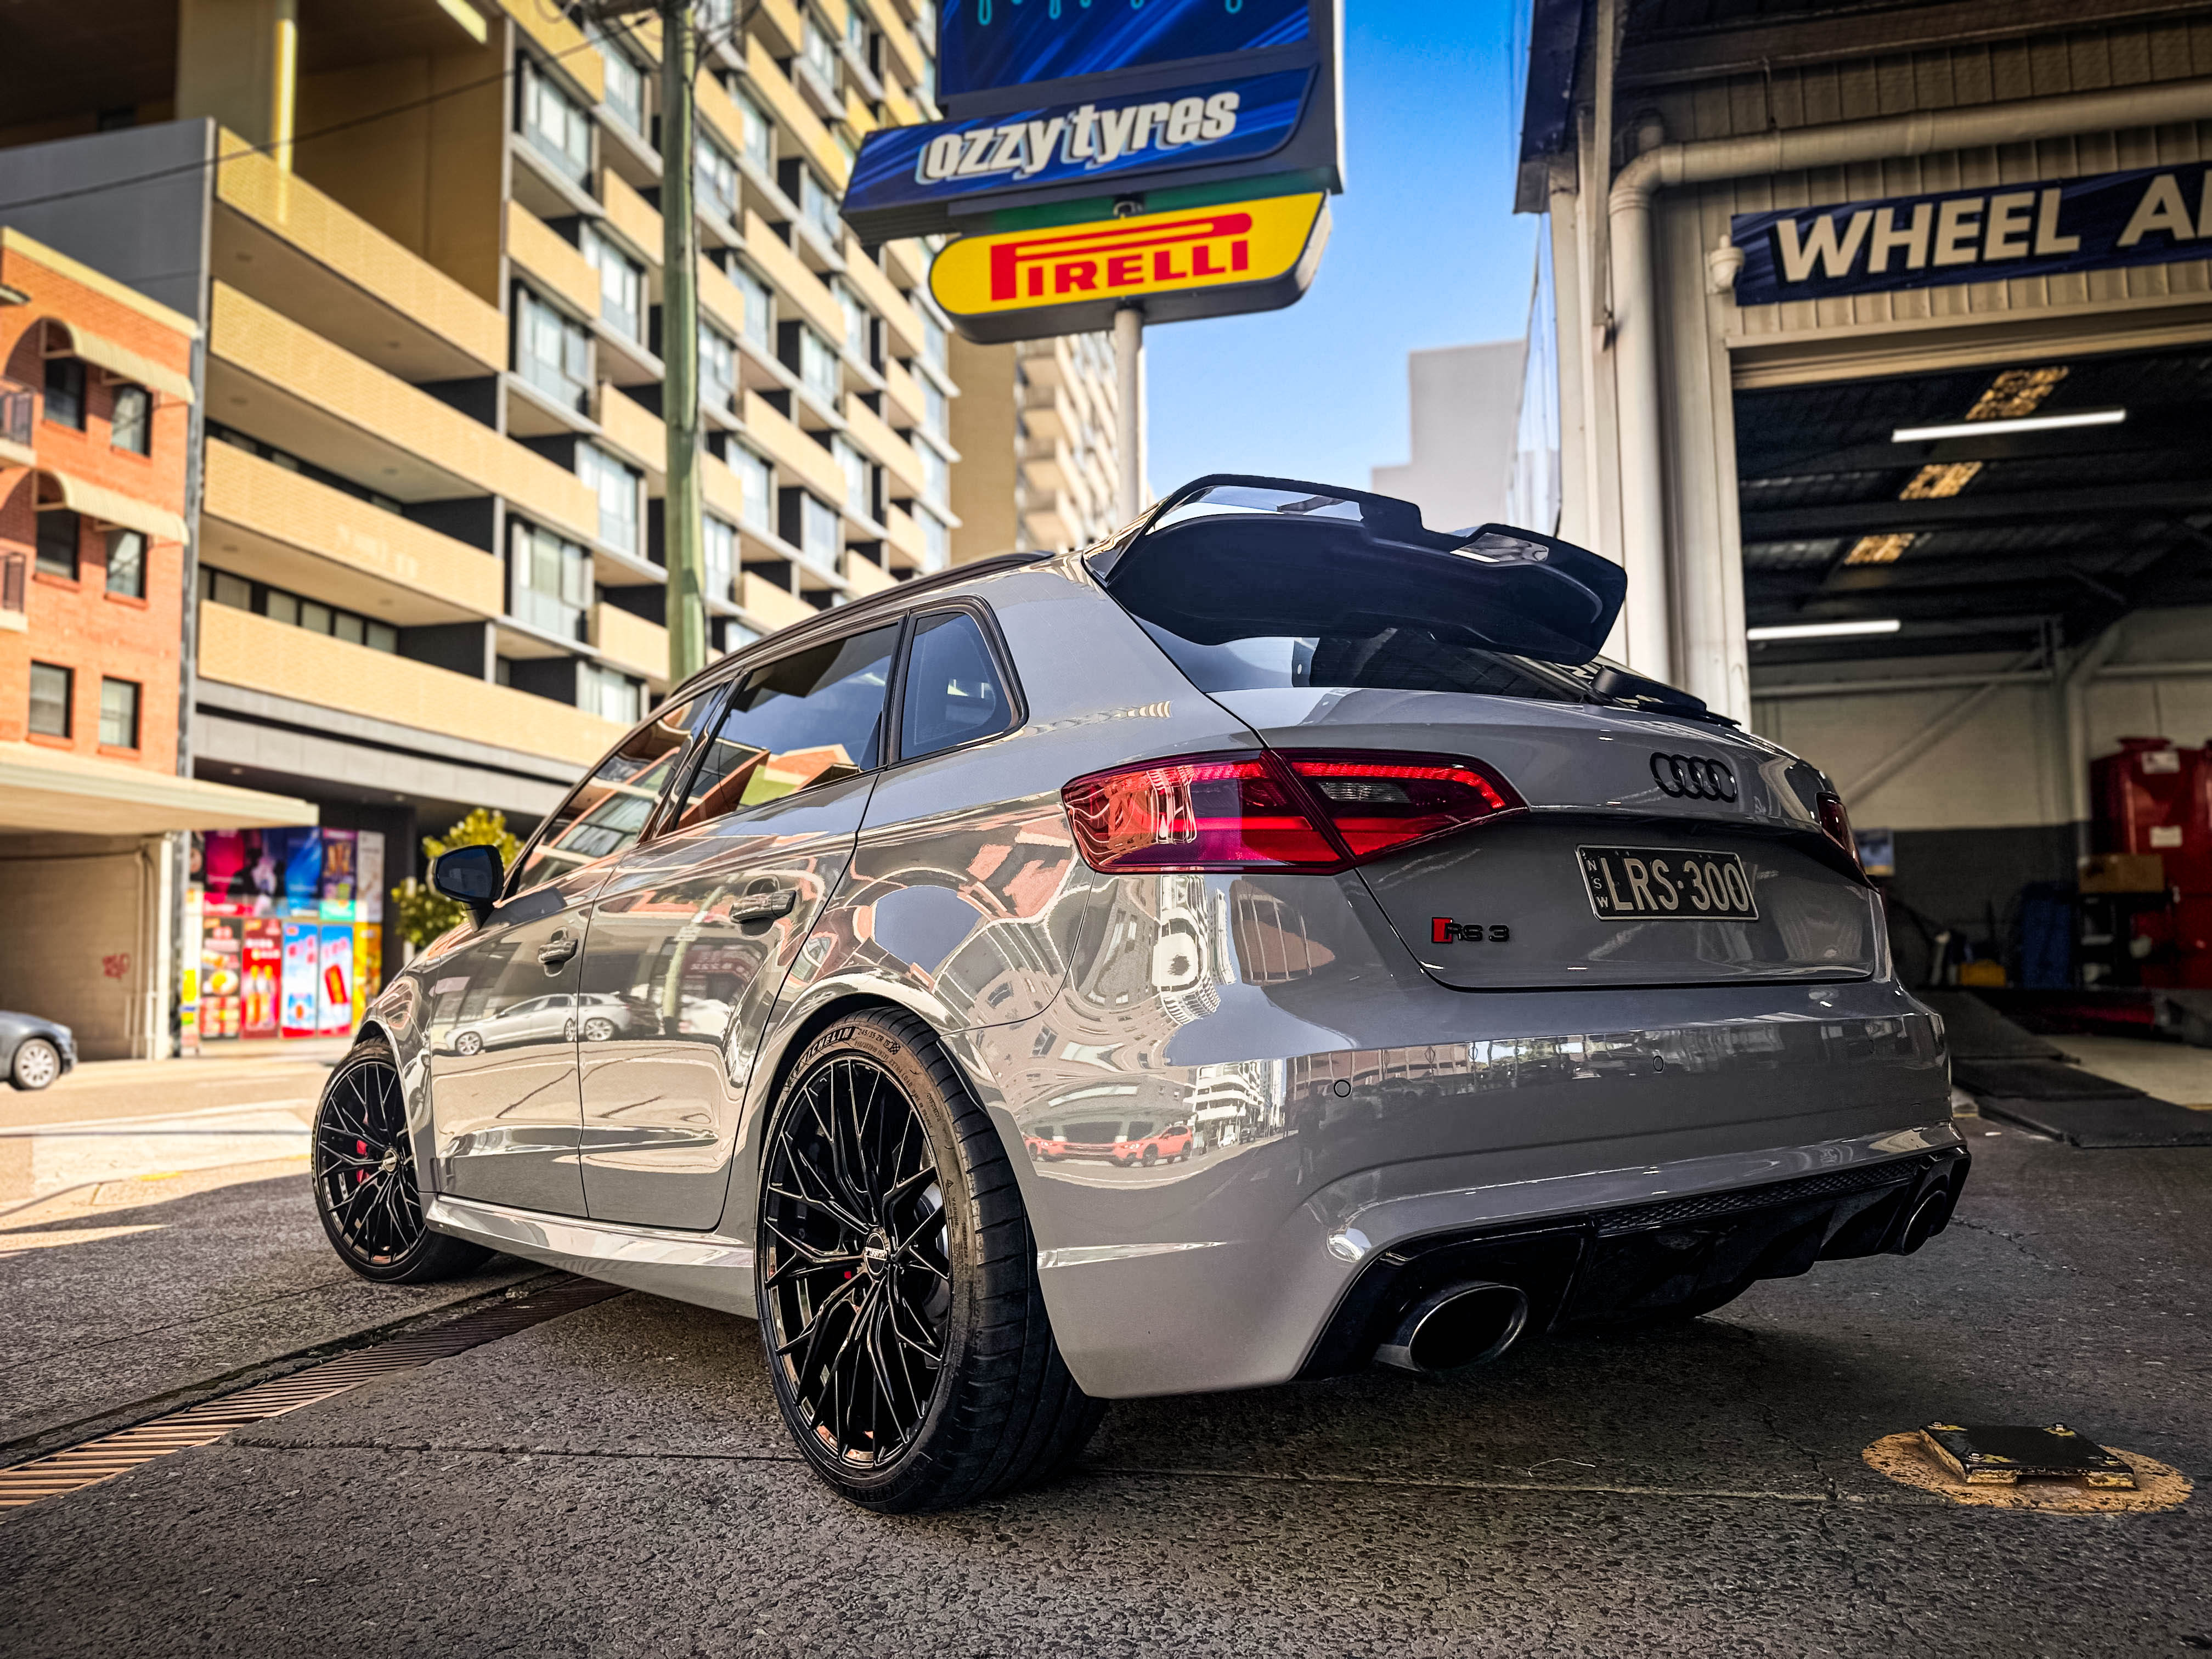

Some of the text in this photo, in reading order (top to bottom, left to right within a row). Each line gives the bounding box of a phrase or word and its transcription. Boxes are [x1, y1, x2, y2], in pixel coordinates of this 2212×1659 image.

[990, 212, 1252, 302] PIRELLI
[1776, 188, 2080, 283] WHEEL
[1442, 922, 1509, 942] RS 3
[798, 1027, 853, 1071] MICHELIN
